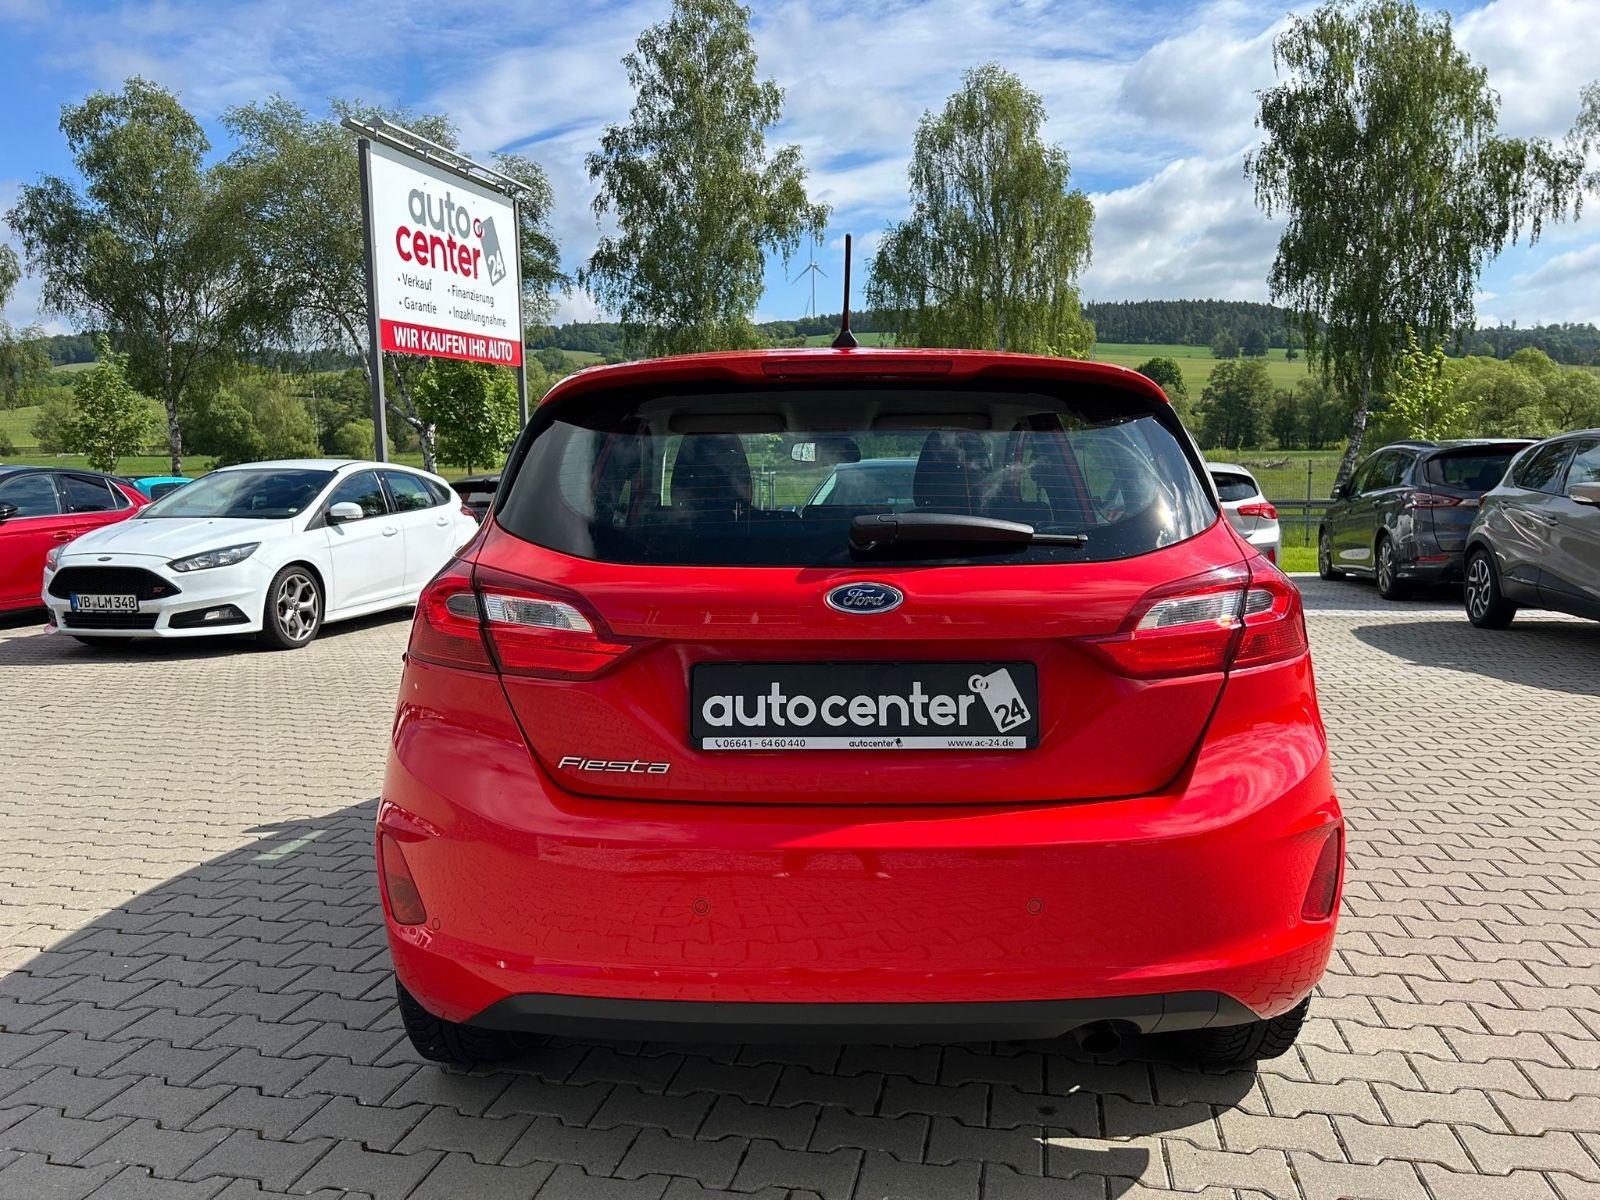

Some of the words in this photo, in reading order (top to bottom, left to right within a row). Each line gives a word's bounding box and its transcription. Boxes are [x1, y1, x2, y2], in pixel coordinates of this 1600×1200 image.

[408, 188, 470, 239] auto
[396, 225, 480, 279] center
[488, 250, 505, 279] 24
[402, 272, 432, 291] Verkauf
[404, 296, 437, 314] Garantie
[452, 284, 494, 307] Finanzierung
[453, 306, 507, 328] Inzahlungnahme
[393, 325, 419, 349] WIR
[421, 330, 466, 355] KAUFEN
[469, 338, 486, 357] IHR
[488, 341, 513, 361] AUTO
[77, 596, 91, 608] VB
[843, 588, 886, 606] Ford
[994, 697, 1027, 730] 24
[848, 738, 894, 748] autocenter
[947, 738, 1014, 748] www.ac-24.de
[558, 756, 671, 774] Fiesta
